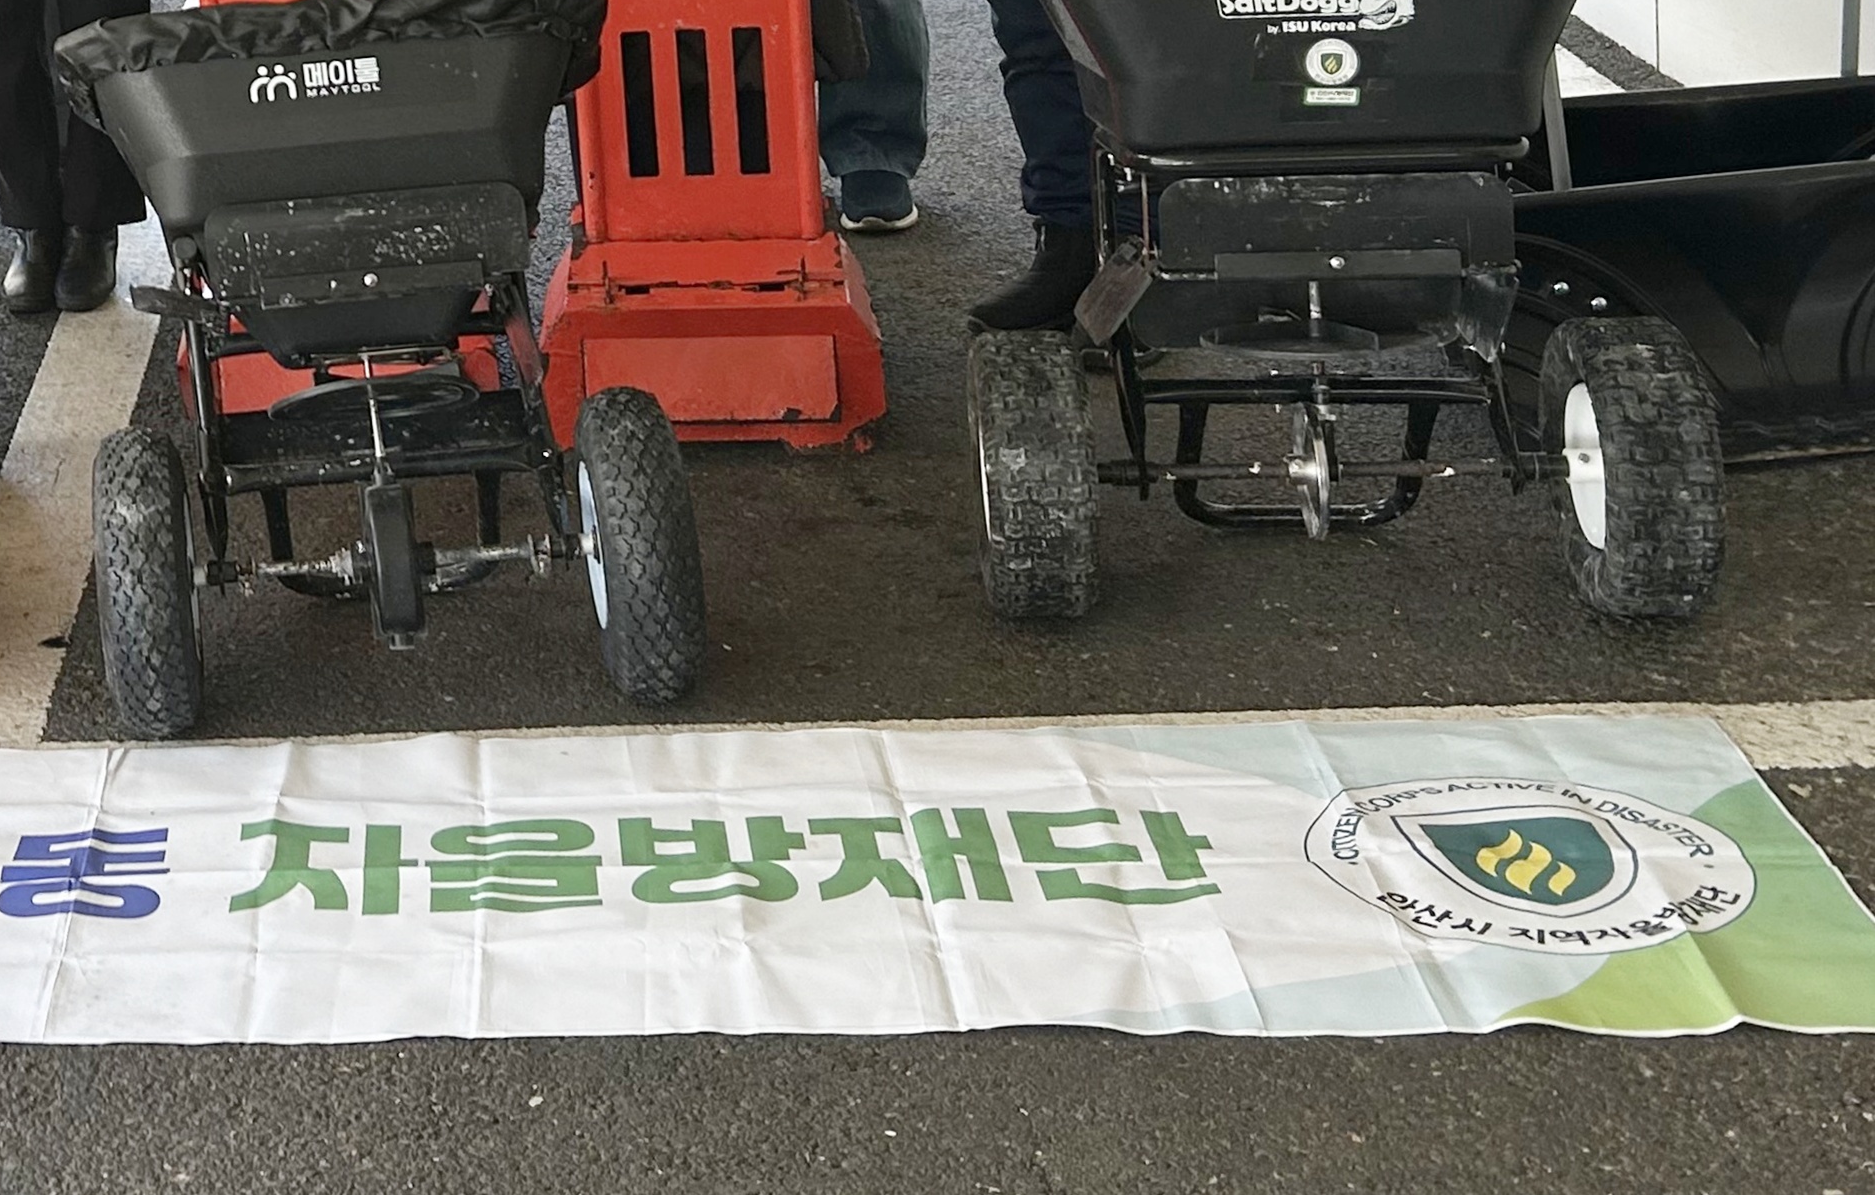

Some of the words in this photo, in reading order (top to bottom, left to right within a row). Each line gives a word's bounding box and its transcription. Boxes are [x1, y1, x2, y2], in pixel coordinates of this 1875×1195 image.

[1282, 20, 1309, 33] ISU
[1310, 19, 1356, 32] Korea
[302, 57, 380, 87] 메이툴
[1331, 807, 1369, 860] CITIZEN
[1354, 787, 1443, 812] CORPS
[1448, 781, 1555, 793] ACTIVE
[1561, 789, 1592, 804] IN
[1594, 800, 1714, 857] DISASTER
[229, 807, 1222, 915] 자율방재단
[1376, 892, 1492, 935] 안산시
[1509, 885, 1740, 945] 지역자율방재단
